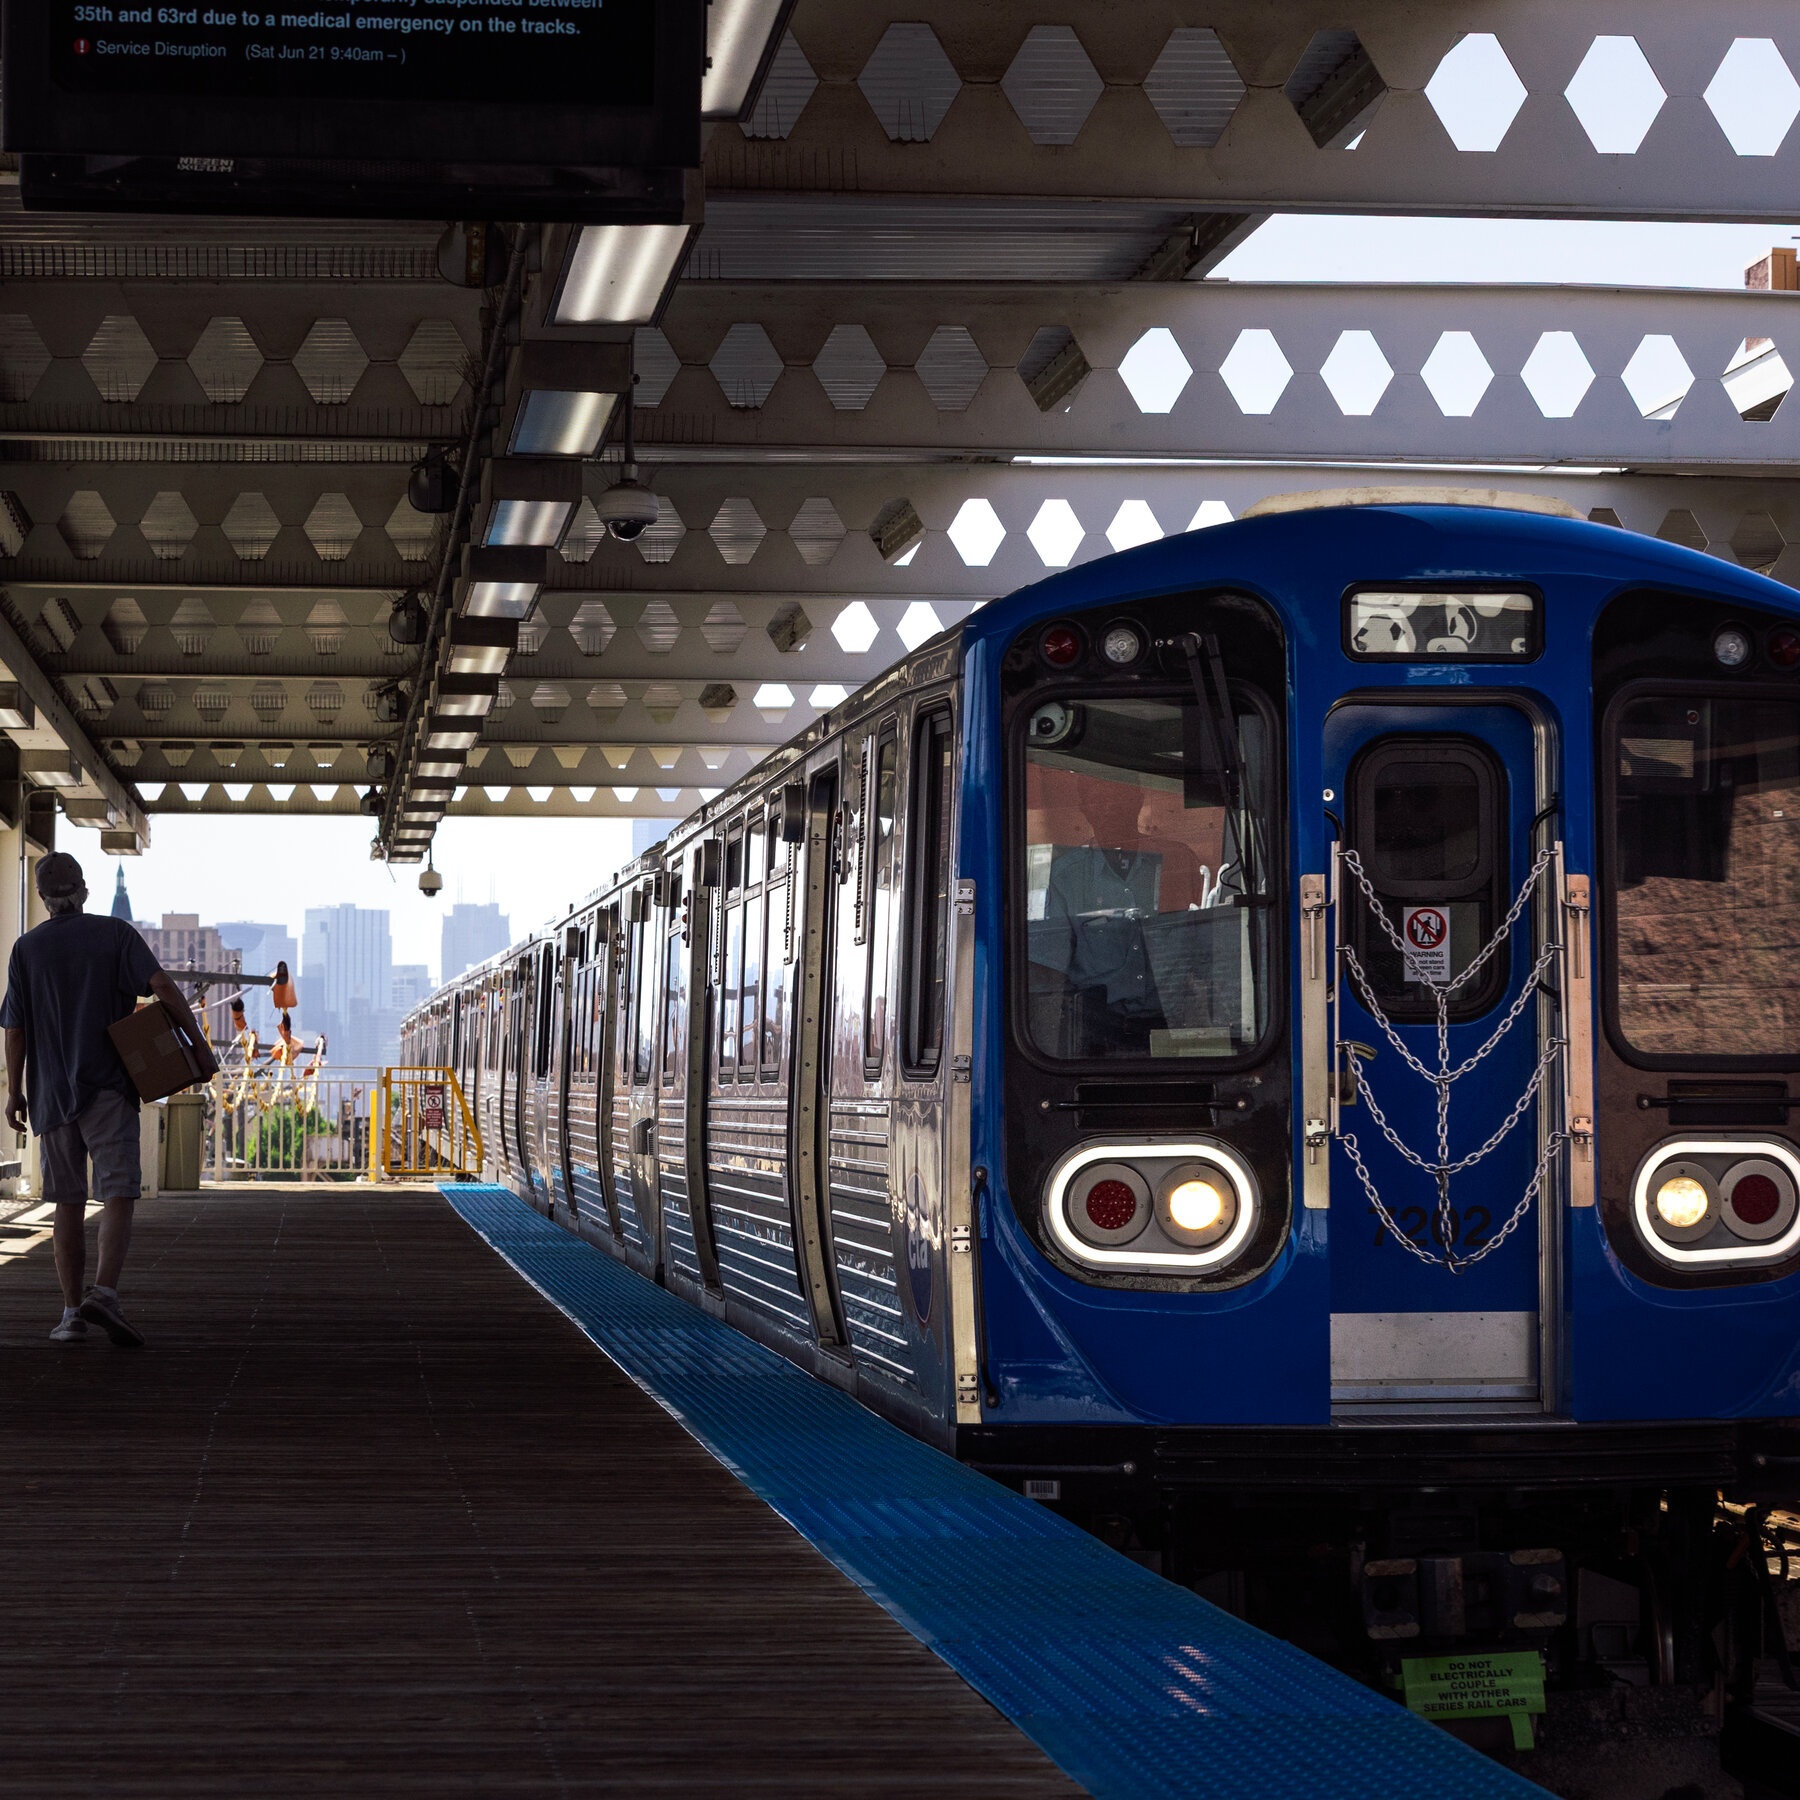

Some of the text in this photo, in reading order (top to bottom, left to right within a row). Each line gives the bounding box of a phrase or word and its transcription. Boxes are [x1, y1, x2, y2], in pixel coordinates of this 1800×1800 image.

[74, 5, 581, 35] 35th and 63rd due to a medical emergency on the tracks.
[96, 40, 150, 56] Service
[154, 42, 227, 60] Disruption
[245, 44, 275, 60] (Sat
[278, 45, 305, 60] Jun
[308, 46, 325, 60] 21
[330, 46, 384, 61] 9:40am
[1368, 1205, 1492, 1247] 7202
[1449, 1660, 1492, 1670] DO NOT
[1430, 1668, 1513, 1682] ELECTRICALLY
[1450, 1679, 1496, 1690] COUPLE
[1438, 1688, 1510, 1701] WITH OTHER
[1423, 1697, 1527, 1713] SERIES RAIL CARS
